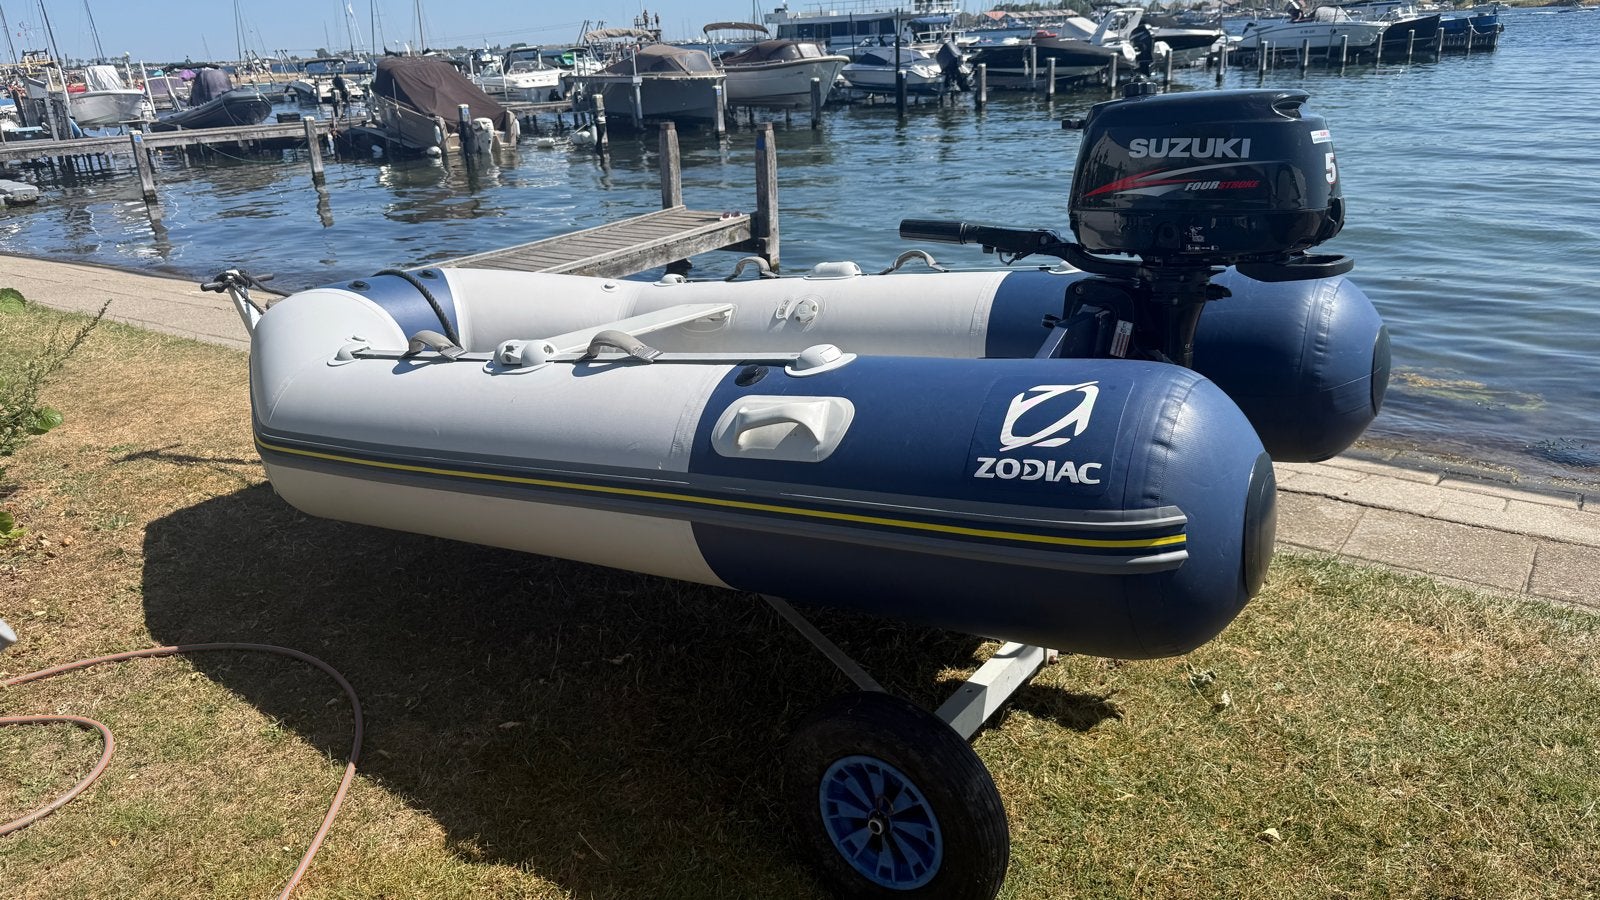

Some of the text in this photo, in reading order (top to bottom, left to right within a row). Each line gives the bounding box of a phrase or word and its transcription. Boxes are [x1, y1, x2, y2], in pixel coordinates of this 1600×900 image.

[1129, 137, 1251, 159] SUZUKI
[1325, 152, 1337, 184] 5
[973, 457, 1102, 485] ZODIAC
